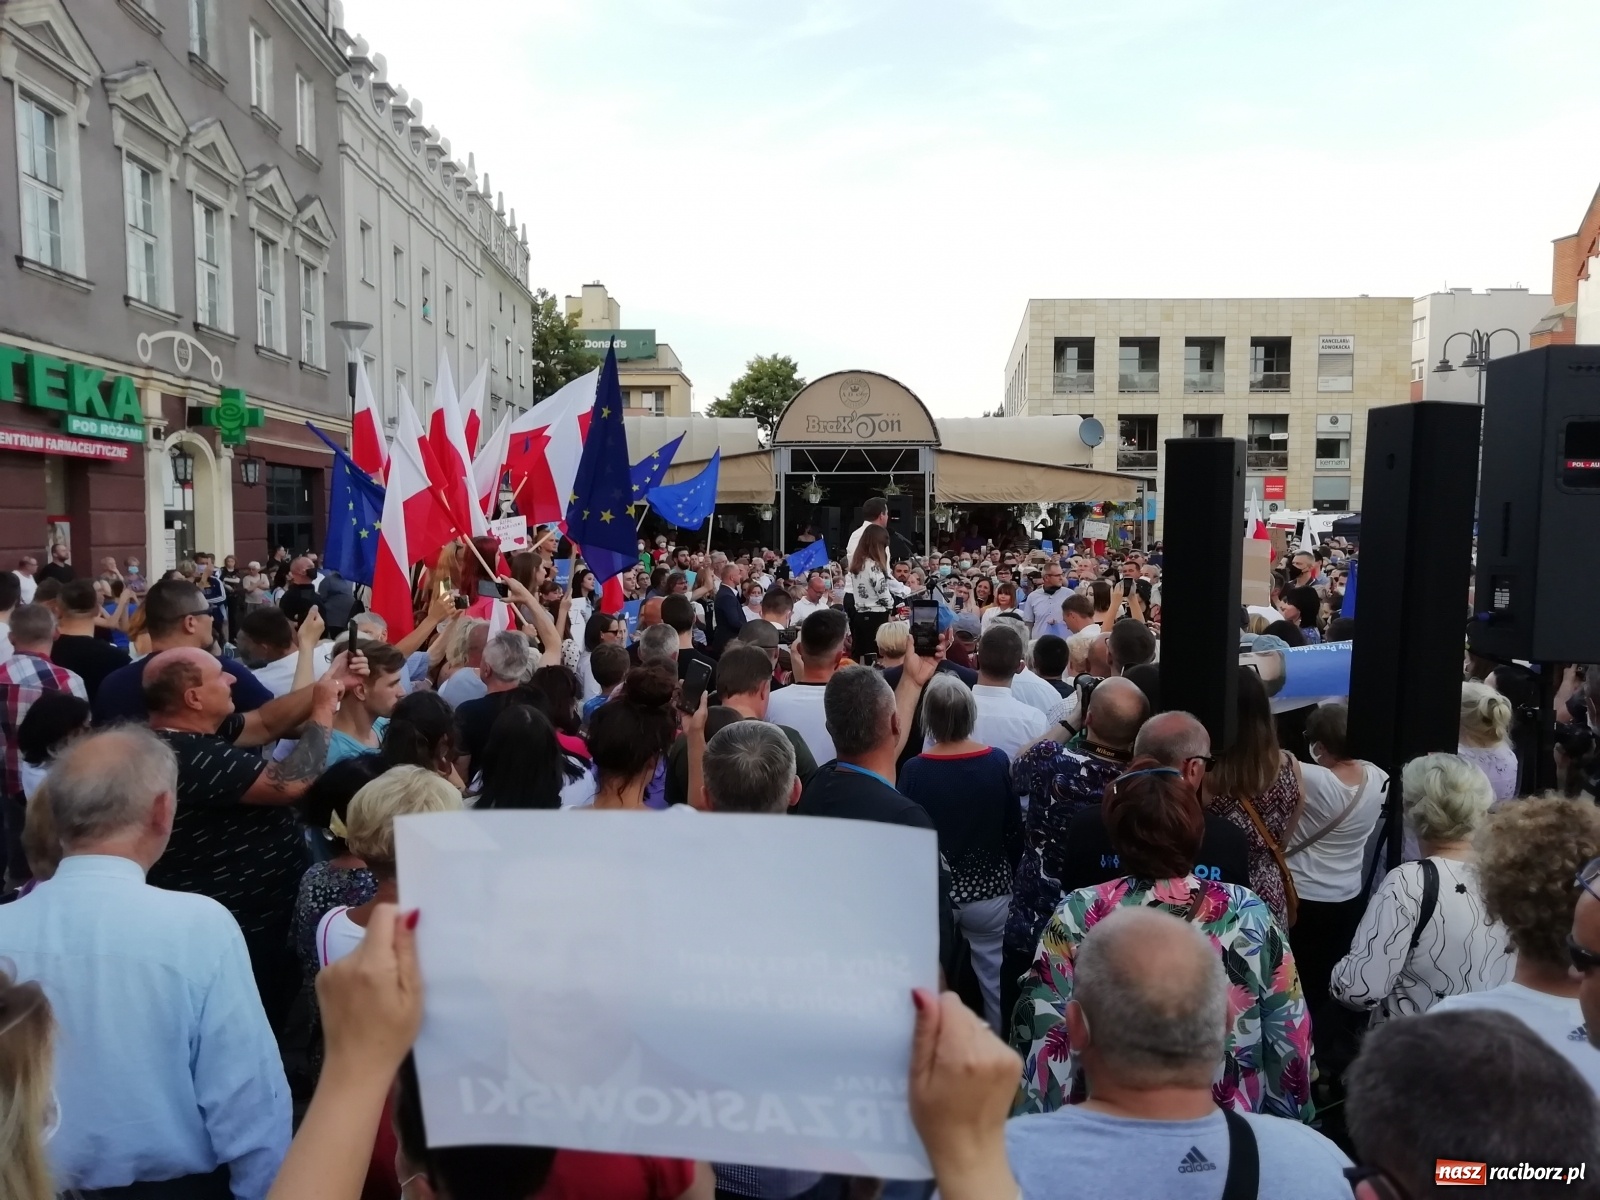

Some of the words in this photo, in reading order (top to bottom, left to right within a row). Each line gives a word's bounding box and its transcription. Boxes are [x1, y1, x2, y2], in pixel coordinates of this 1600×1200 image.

[72, 419, 98, 434] POD
[101, 422, 143, 440] RÓŻAMI
[45, 437, 129, 458] FARMACEUTYCZNE
[1095, 747, 1115, 757] Nikon
[1178, 1162, 1217, 1173] adidas
